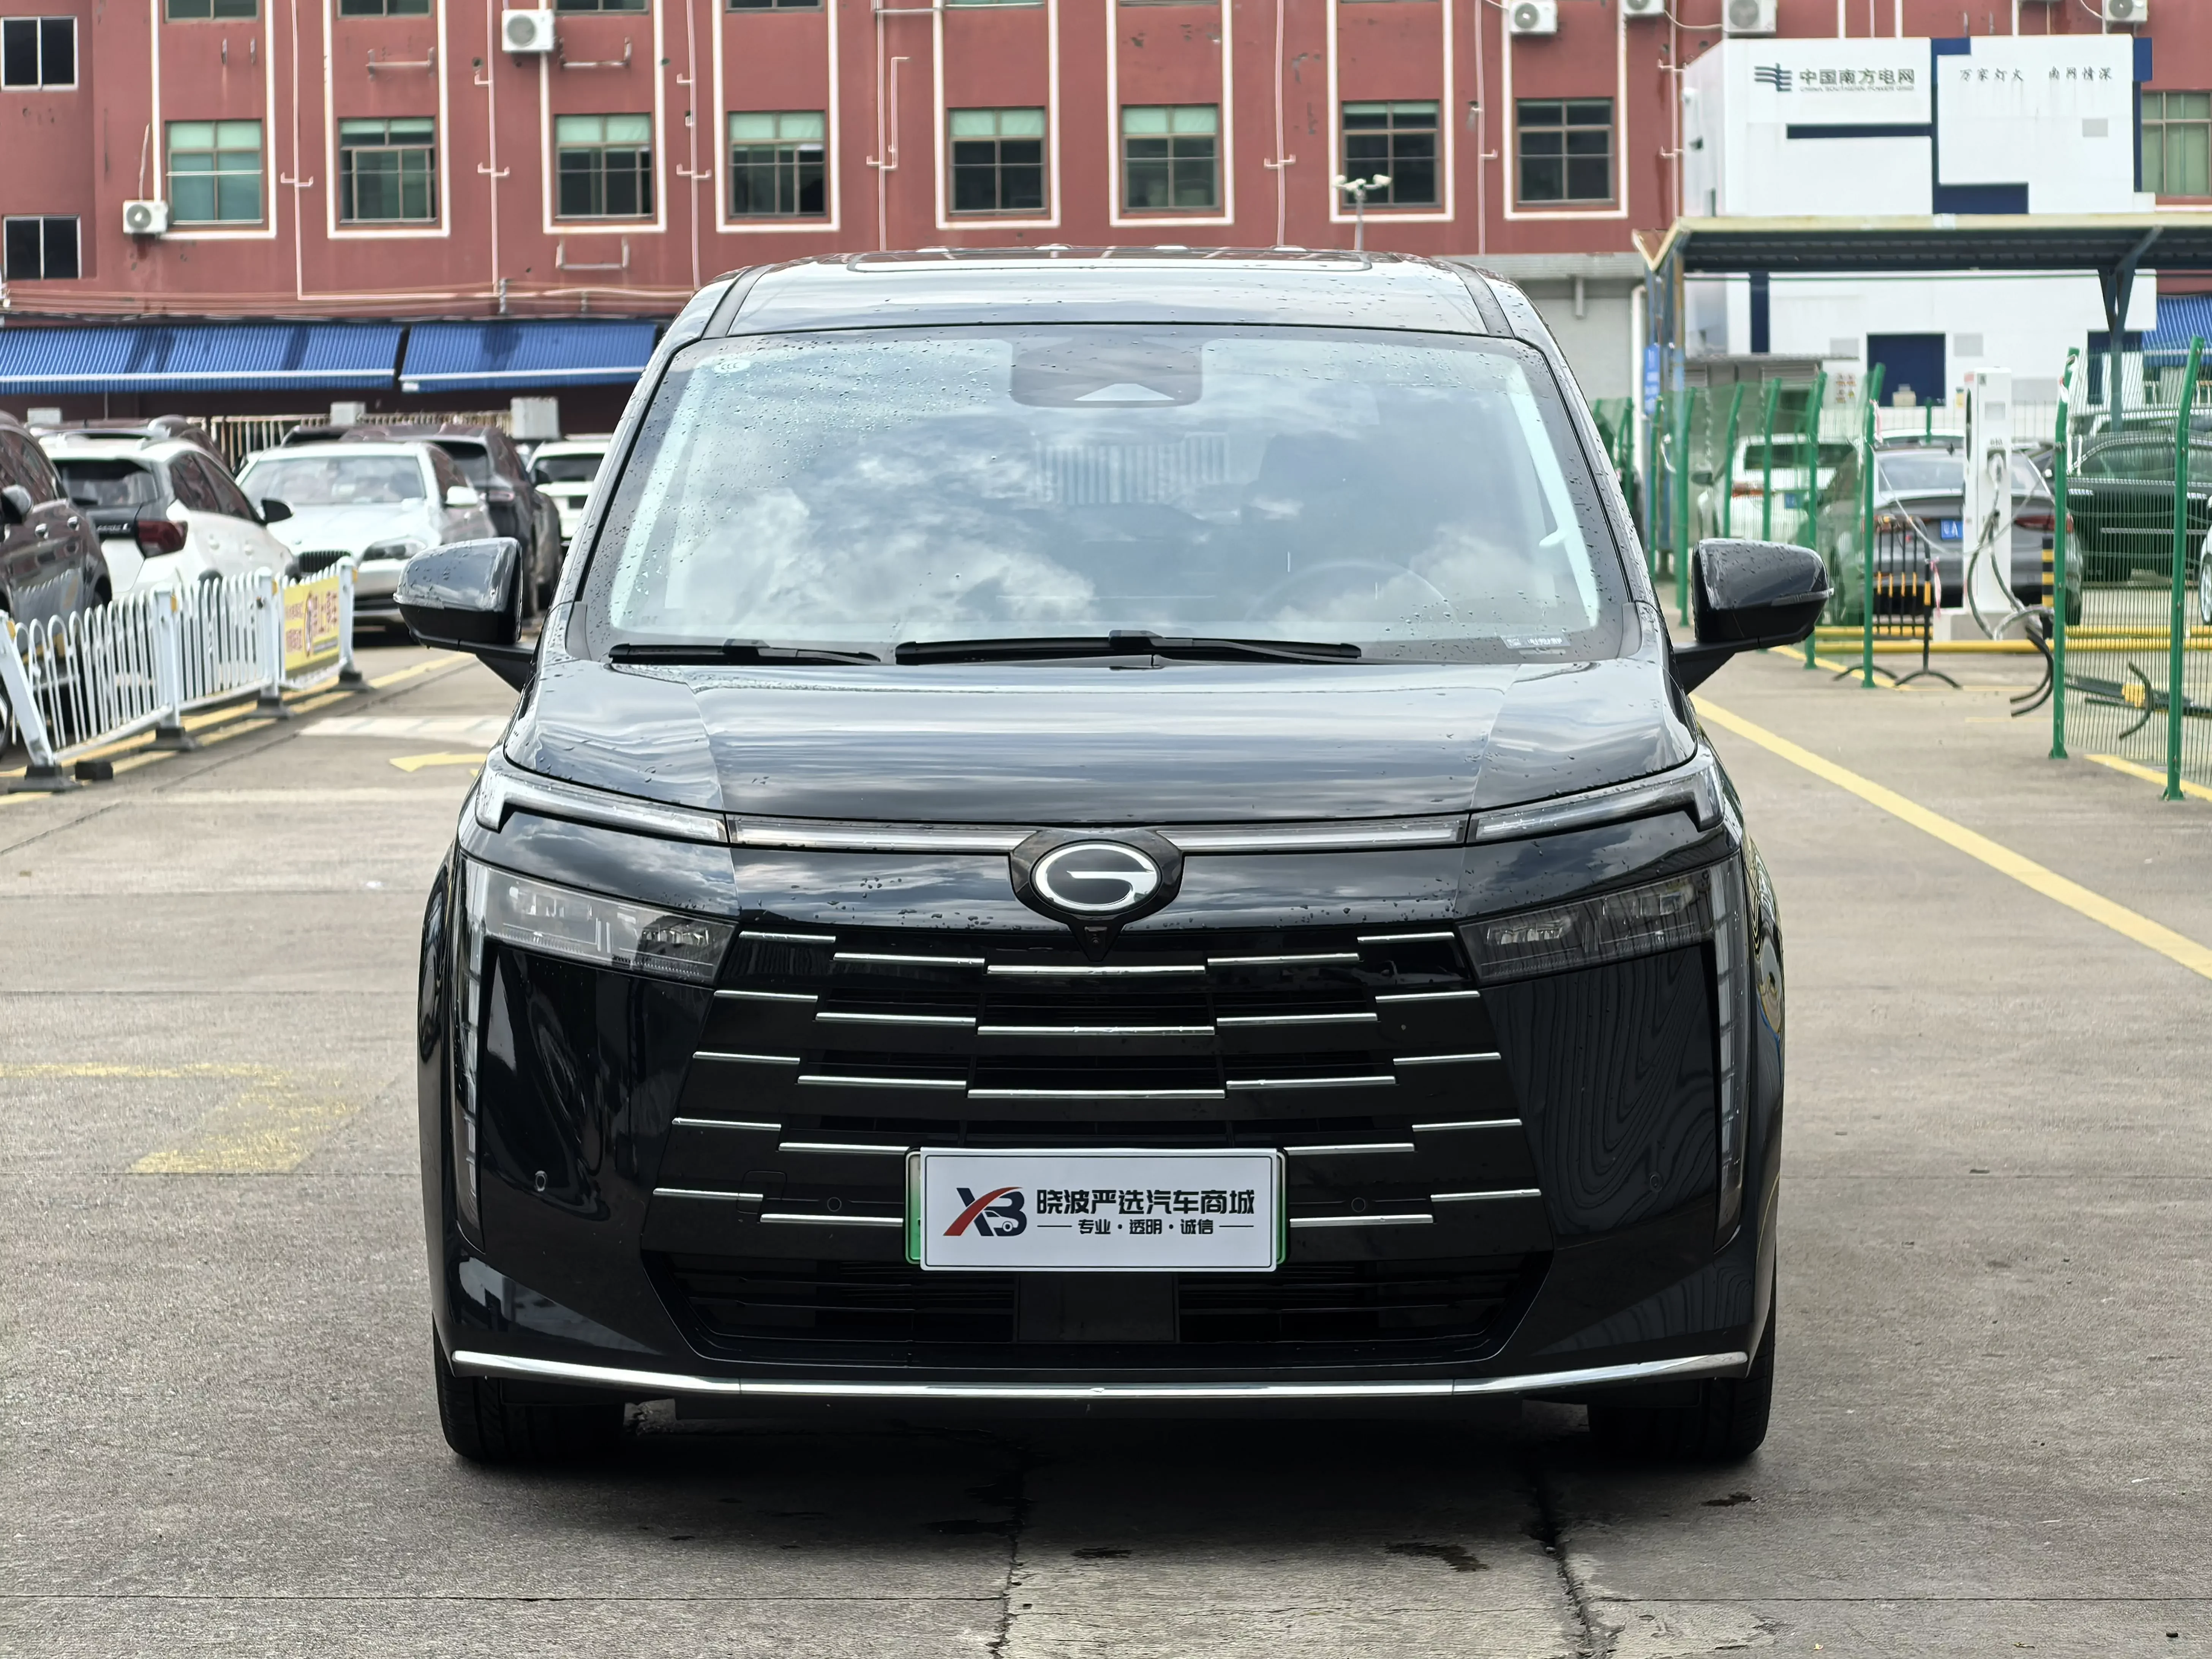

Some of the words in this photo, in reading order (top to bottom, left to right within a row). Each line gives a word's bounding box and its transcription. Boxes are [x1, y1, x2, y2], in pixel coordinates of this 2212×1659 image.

[1800, 68, 1915, 85] 中国南方电网
[1037, 1190, 1255, 1214] 晓波严选汽车商城
